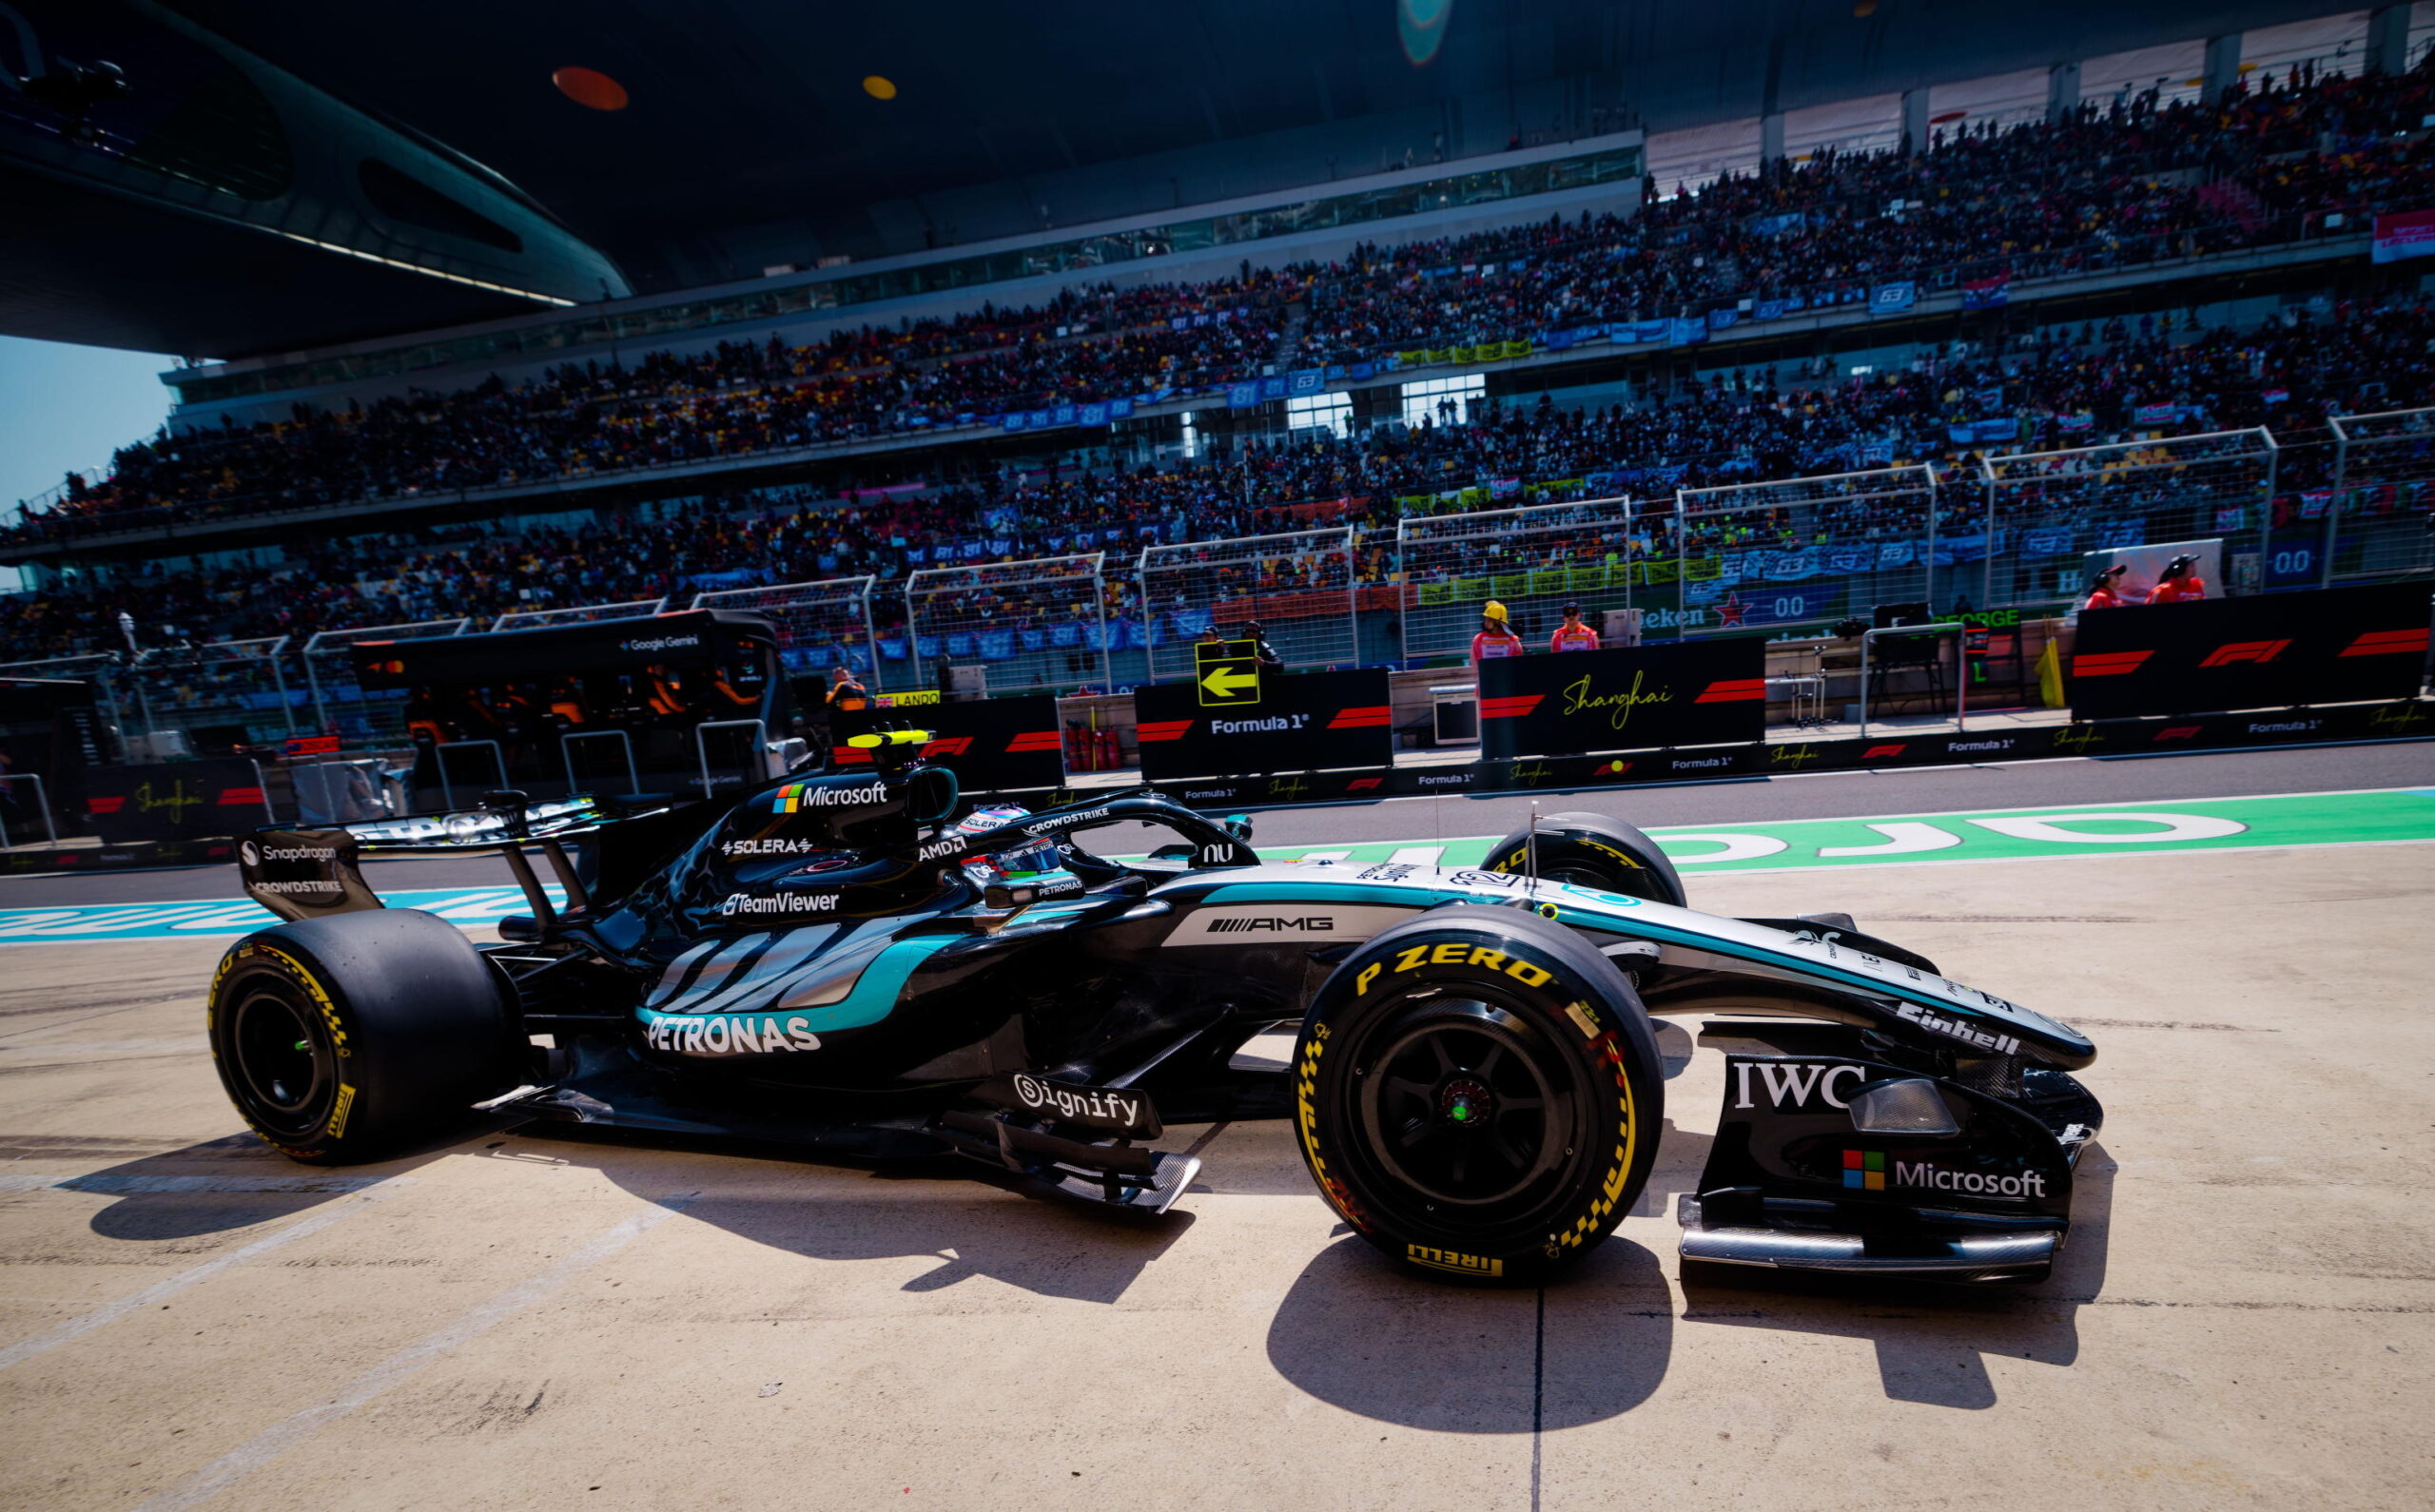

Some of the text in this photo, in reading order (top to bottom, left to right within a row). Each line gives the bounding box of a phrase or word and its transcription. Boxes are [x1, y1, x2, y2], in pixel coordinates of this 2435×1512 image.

[1775, 596, 1804, 618] 0.0
[630, 634, 699, 651] Google Gemini
[895, 692, 939, 708] LANDO
[1563, 669, 1674, 730] Shanghai
[1211, 716, 1289, 735] Formula
[2249, 720, 2306, 734] Formula
[1948, 739, 1999, 752] Formula
[2053, 727, 2108, 753] Shanghai
[1671, 759, 1720, 771] Formula
[1770, 746, 1820, 769] Shanghai
[1418, 774, 1462, 785] Formula
[1509, 762, 1553, 785] Shanghai
[804, 781, 887, 807] Microsoft
[1184, 789, 1225, 800] Formula
[1268, 777, 1310, 800] Shanghai
[1028, 808, 1110, 833] CROWDSTRIKE
[263, 843, 337, 863] Snapdragon
[733, 840, 799, 855] SOLERA
[918, 840, 953, 862] AMD
[256, 881, 344, 894] CROWDSTRIKE
[1039, 881, 1082, 897] PETRONAS
[736, 892, 840, 913] TeamViewer
[1246, 917, 1334, 932] AMG
[1355, 943, 1554, 998] P ZERO
[648, 1016, 822, 1055] PETRONAS
[1896, 1001, 2021, 1056] Einhell
[1732, 1061, 1866, 1110] IWC
[1896, 1160, 2047, 1199] Microsoft
[1407, 1243, 1504, 1278] PIRELLI
